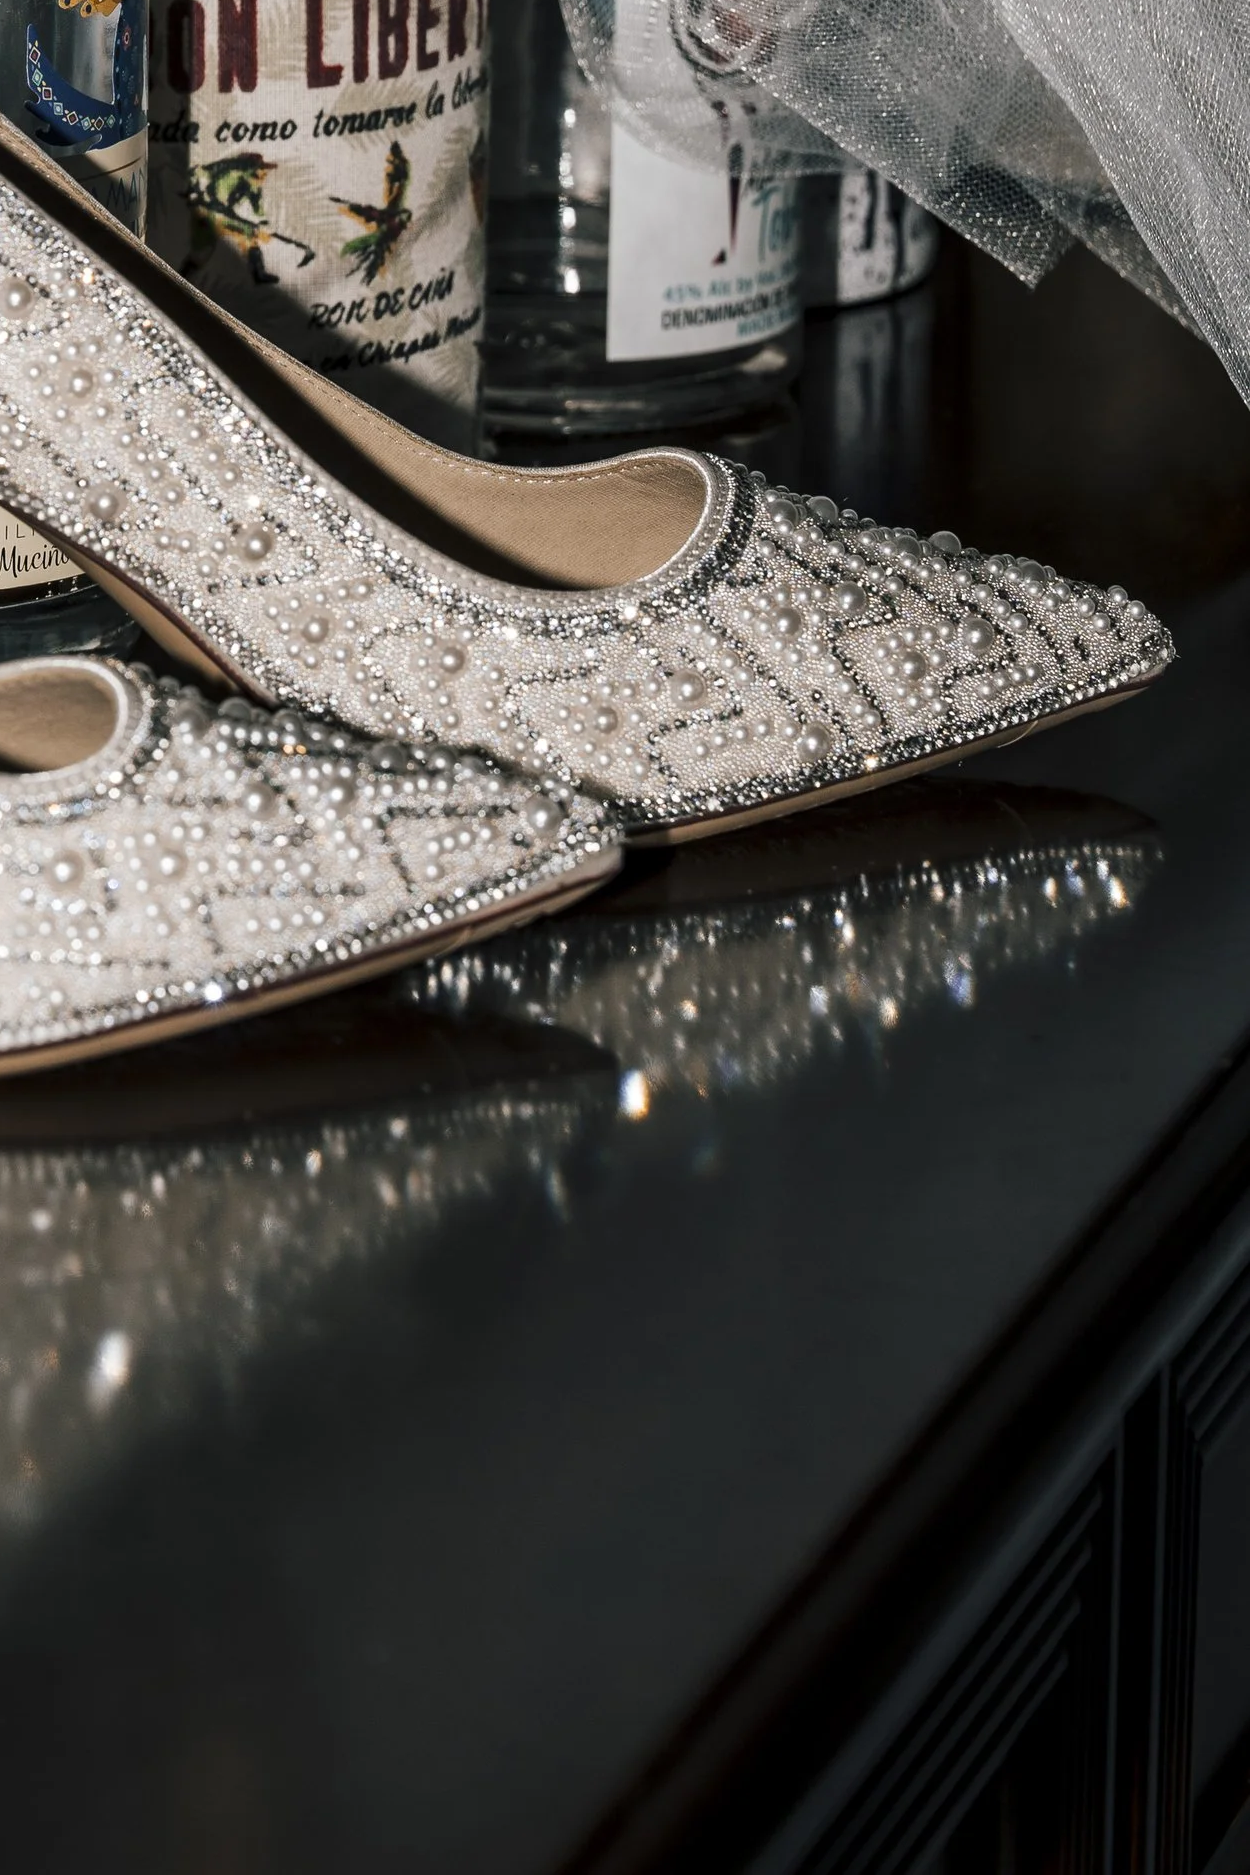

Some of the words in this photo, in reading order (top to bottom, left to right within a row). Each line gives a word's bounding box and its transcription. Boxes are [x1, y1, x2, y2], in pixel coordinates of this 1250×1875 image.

[215, 117, 298, 143] como
[312, 101, 418, 139] tomarse
[372, 285, 406, 321] DE
